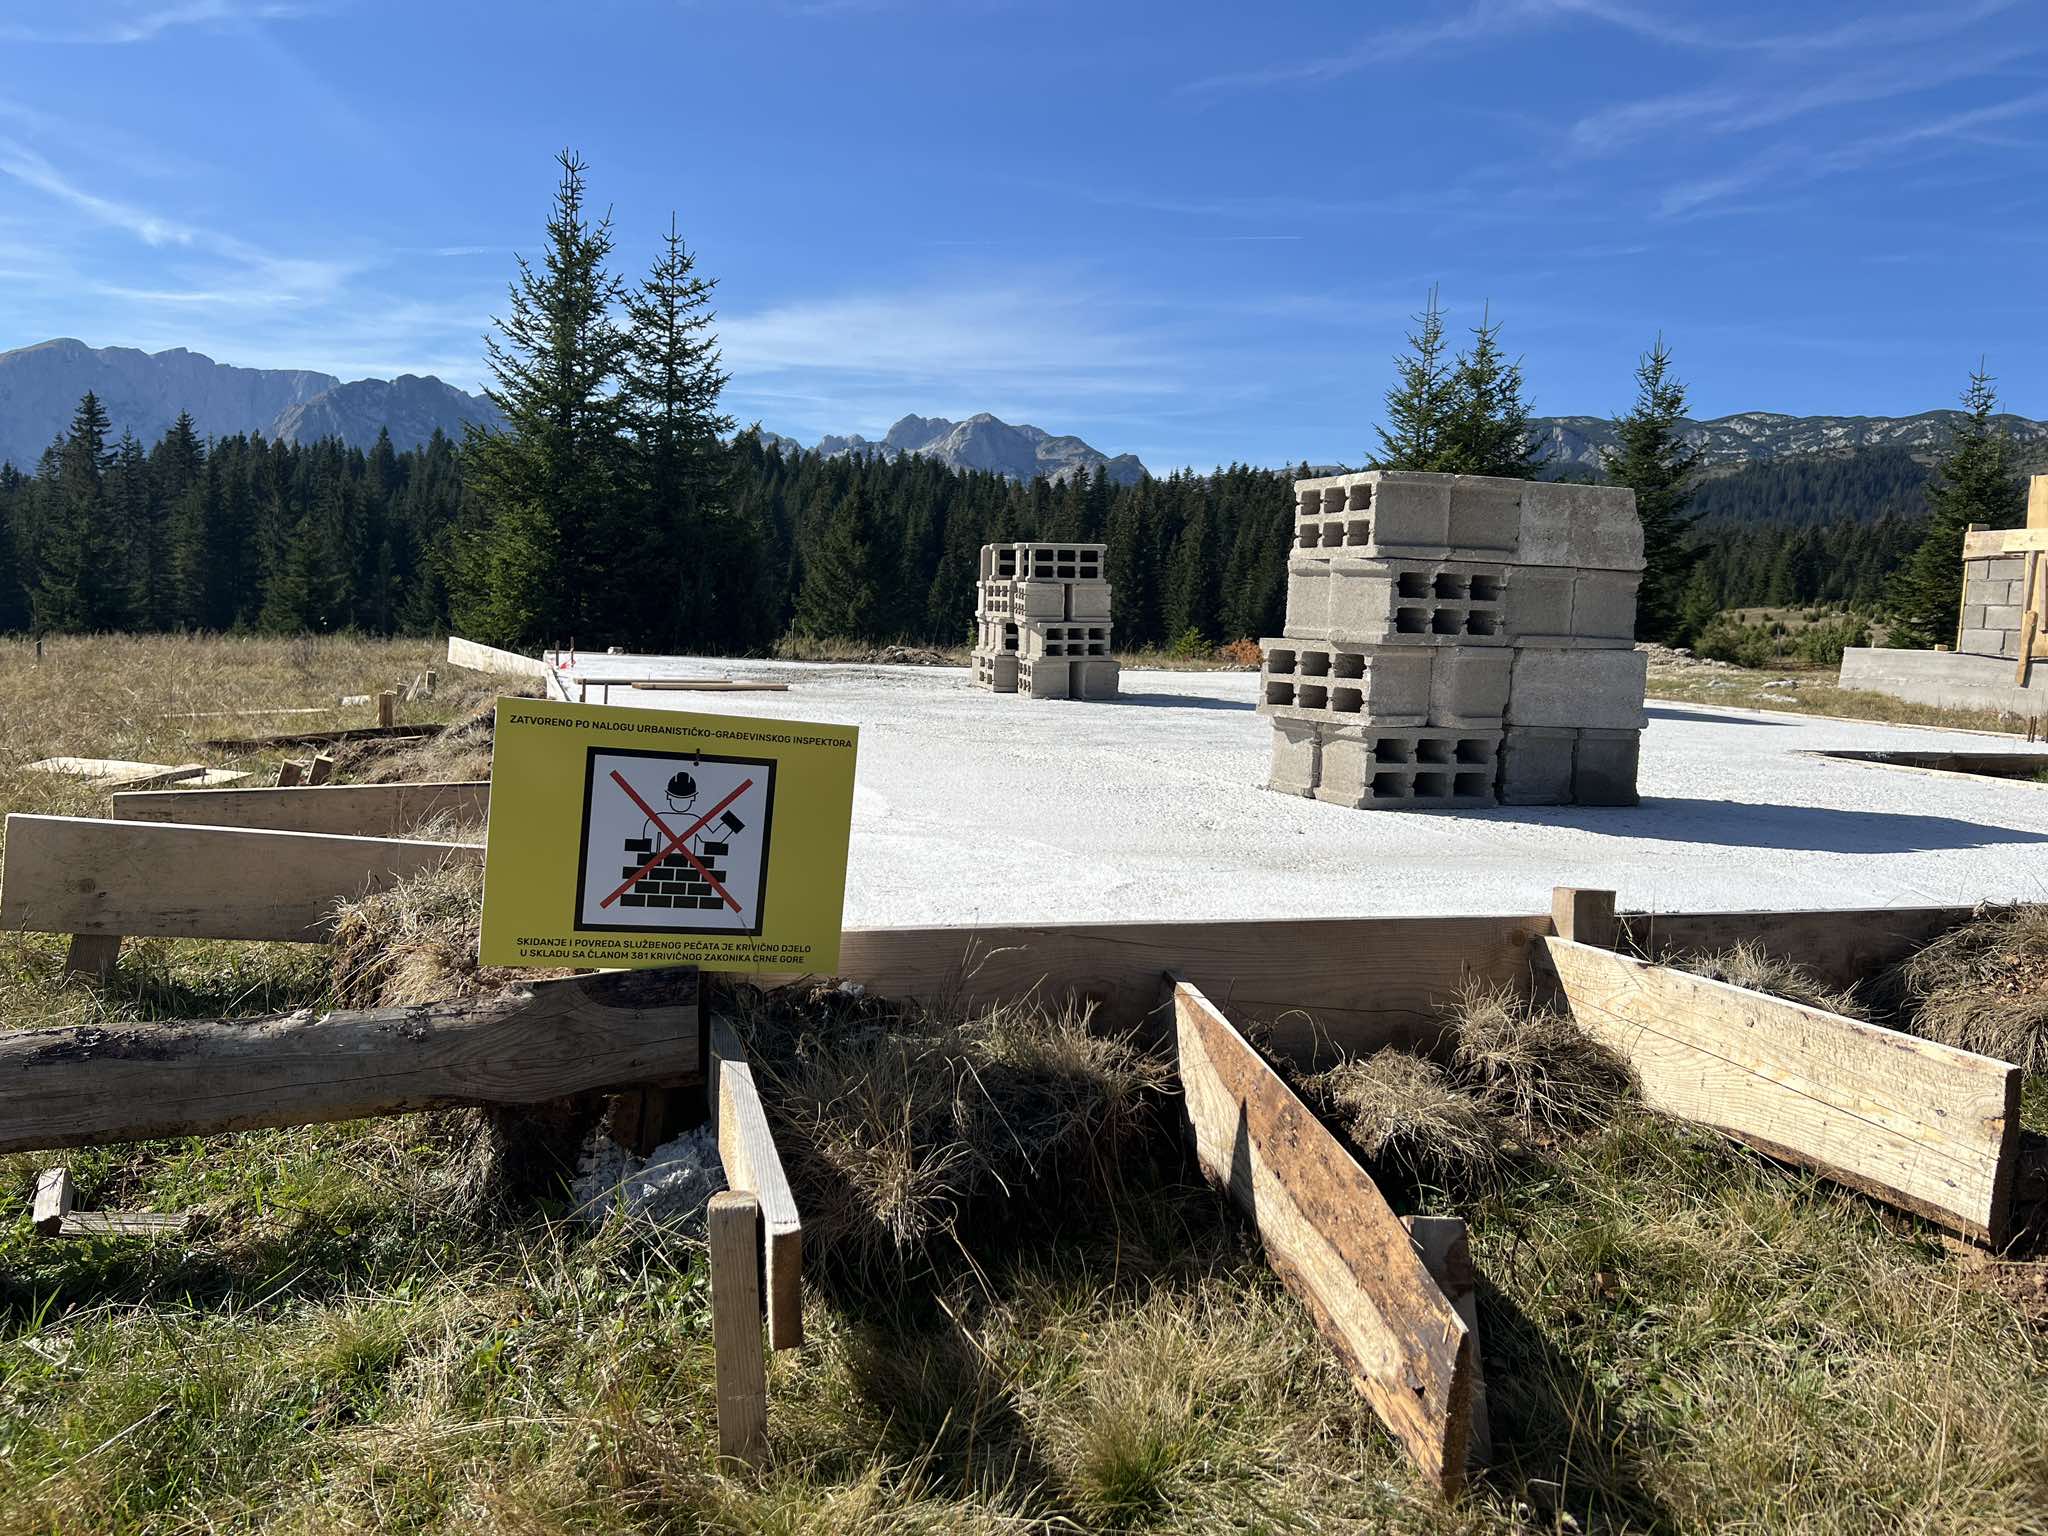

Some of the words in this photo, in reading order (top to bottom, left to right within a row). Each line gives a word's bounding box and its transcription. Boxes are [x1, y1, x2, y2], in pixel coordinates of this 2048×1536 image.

[510, 714, 572, 728] ZATVORENO
[576, 719, 590, 728] PO
[592, 720, 634, 732] NALOGU
[636, 724, 791, 744] URBANISTIČKO-GRAĐEVINSKOG
[793, 736, 852, 748] INSPEKTORA
[516, 938, 567, 946] SKIDANJE
[575, 939, 622, 948] POVREDA
[623, 939, 681, 949] SLUŽBENOG
[684, 940, 720, 950] PEČATA
[722, 943, 733, 951] JE
[736, 942, 779, 952] KRIVIČNO
[782, 945, 812, 953] DJELO
[520, 949, 527, 957] U
[530, 950, 570, 958] SKLADU
[587, 949, 629, 959] ČLANOM
[650, 951, 702, 961] KRIVIČNOG
[704, 954, 750, 962] ZAKONIKA
[752, 954, 778, 963] CRNE
[780, 956, 804, 964] GORE
